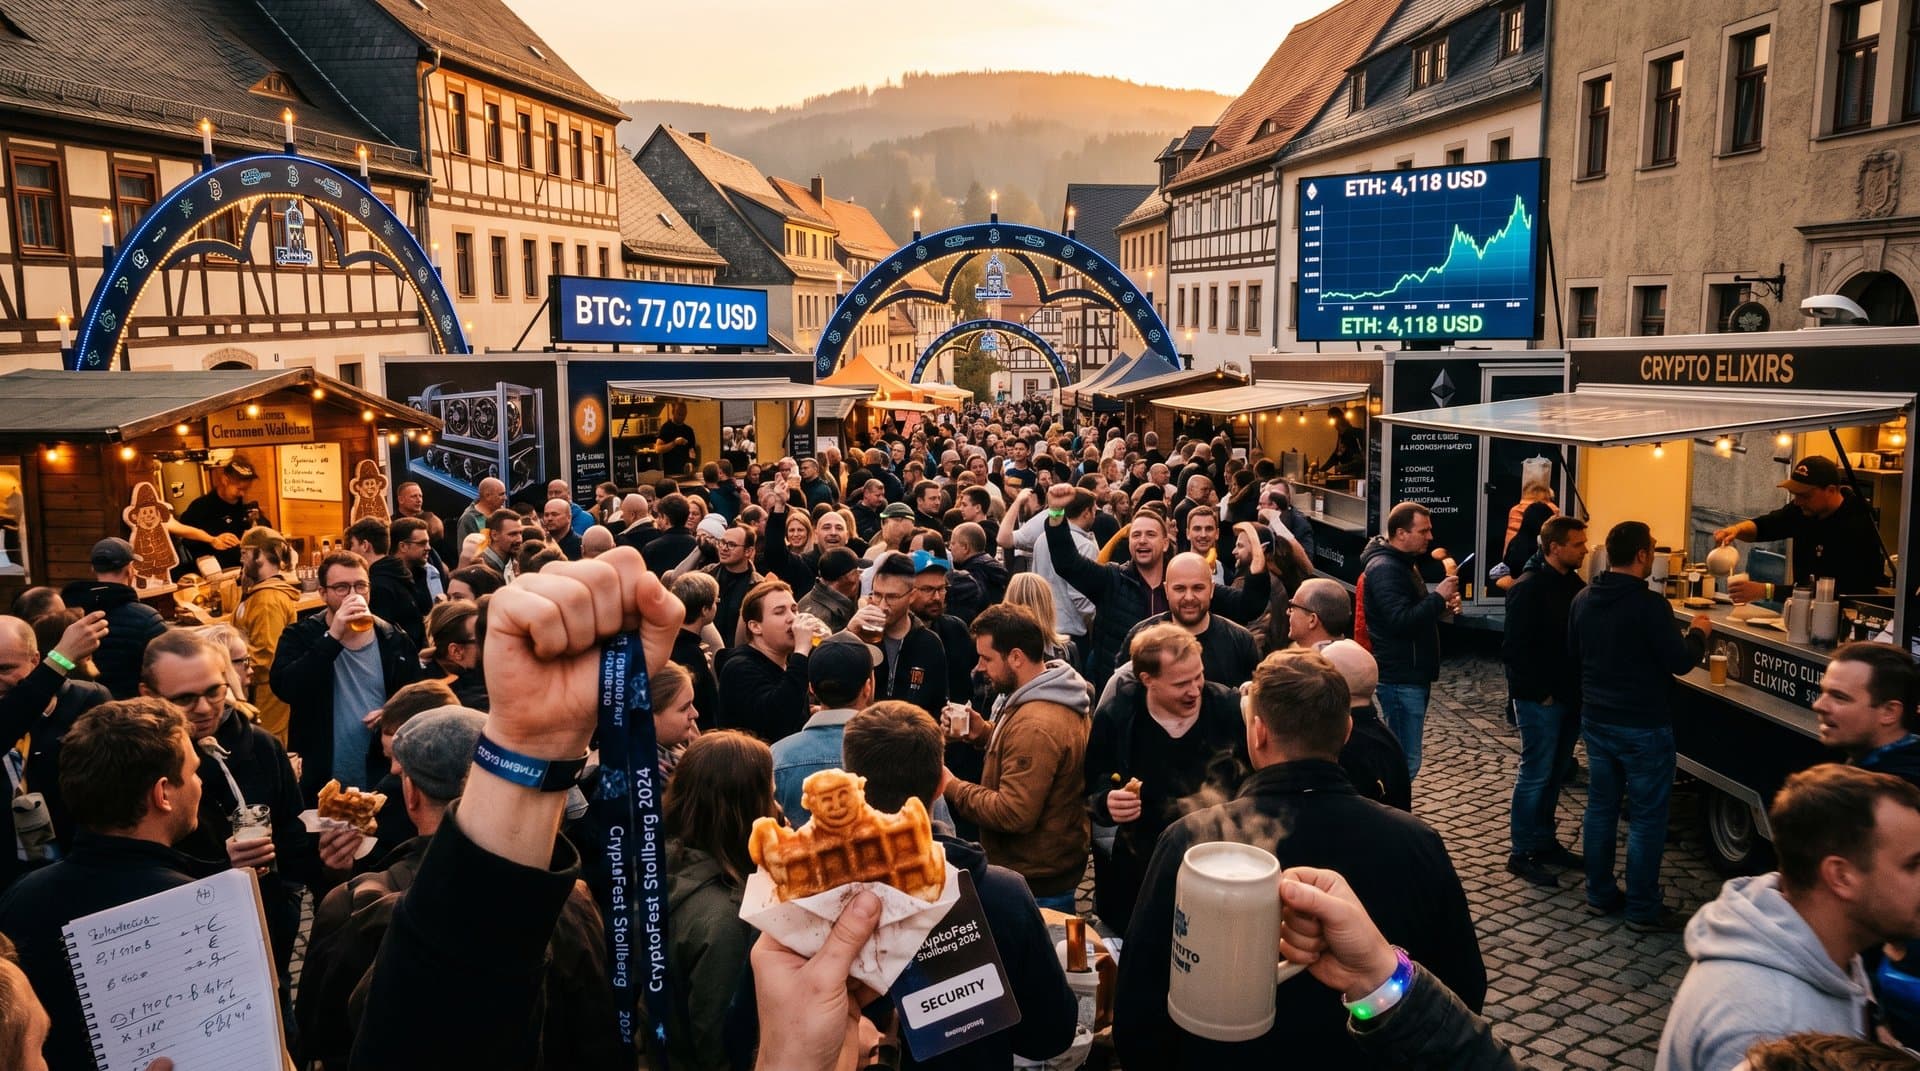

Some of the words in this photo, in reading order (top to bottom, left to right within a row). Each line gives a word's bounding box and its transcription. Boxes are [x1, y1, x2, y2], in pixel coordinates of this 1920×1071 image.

[1345, 177, 1387, 197] ETH:
[1391, 173, 1442, 196] 4,118
[1447, 170, 1487, 189] USD
[576, 295, 632, 327] BTC:
[638, 298, 712, 333] 77,072
[717, 303, 757, 331] USD
[1341, 316, 1383, 335] ETH:
[1387, 316, 1437, 337] 4,118
[1443, 315, 1483, 333] USD
[1640, 354, 1711, 382] CRYPTO
[1715, 353, 1795, 383] ELIXIRS
[1754, 651, 1797, 677] CRYPTO
[1753, 669, 1796, 696] ELIXIRS
[636, 767, 654, 808] 2024
[641, 814, 659, 891] Stollberg
[614, 917, 629, 988] Stollberg
[646, 896, 664, 992] CryptoFest
[958, 931, 981, 947] 2024
[921, 979, 985, 1013] SECURITY
[619, 1011, 630, 1043] 2024
